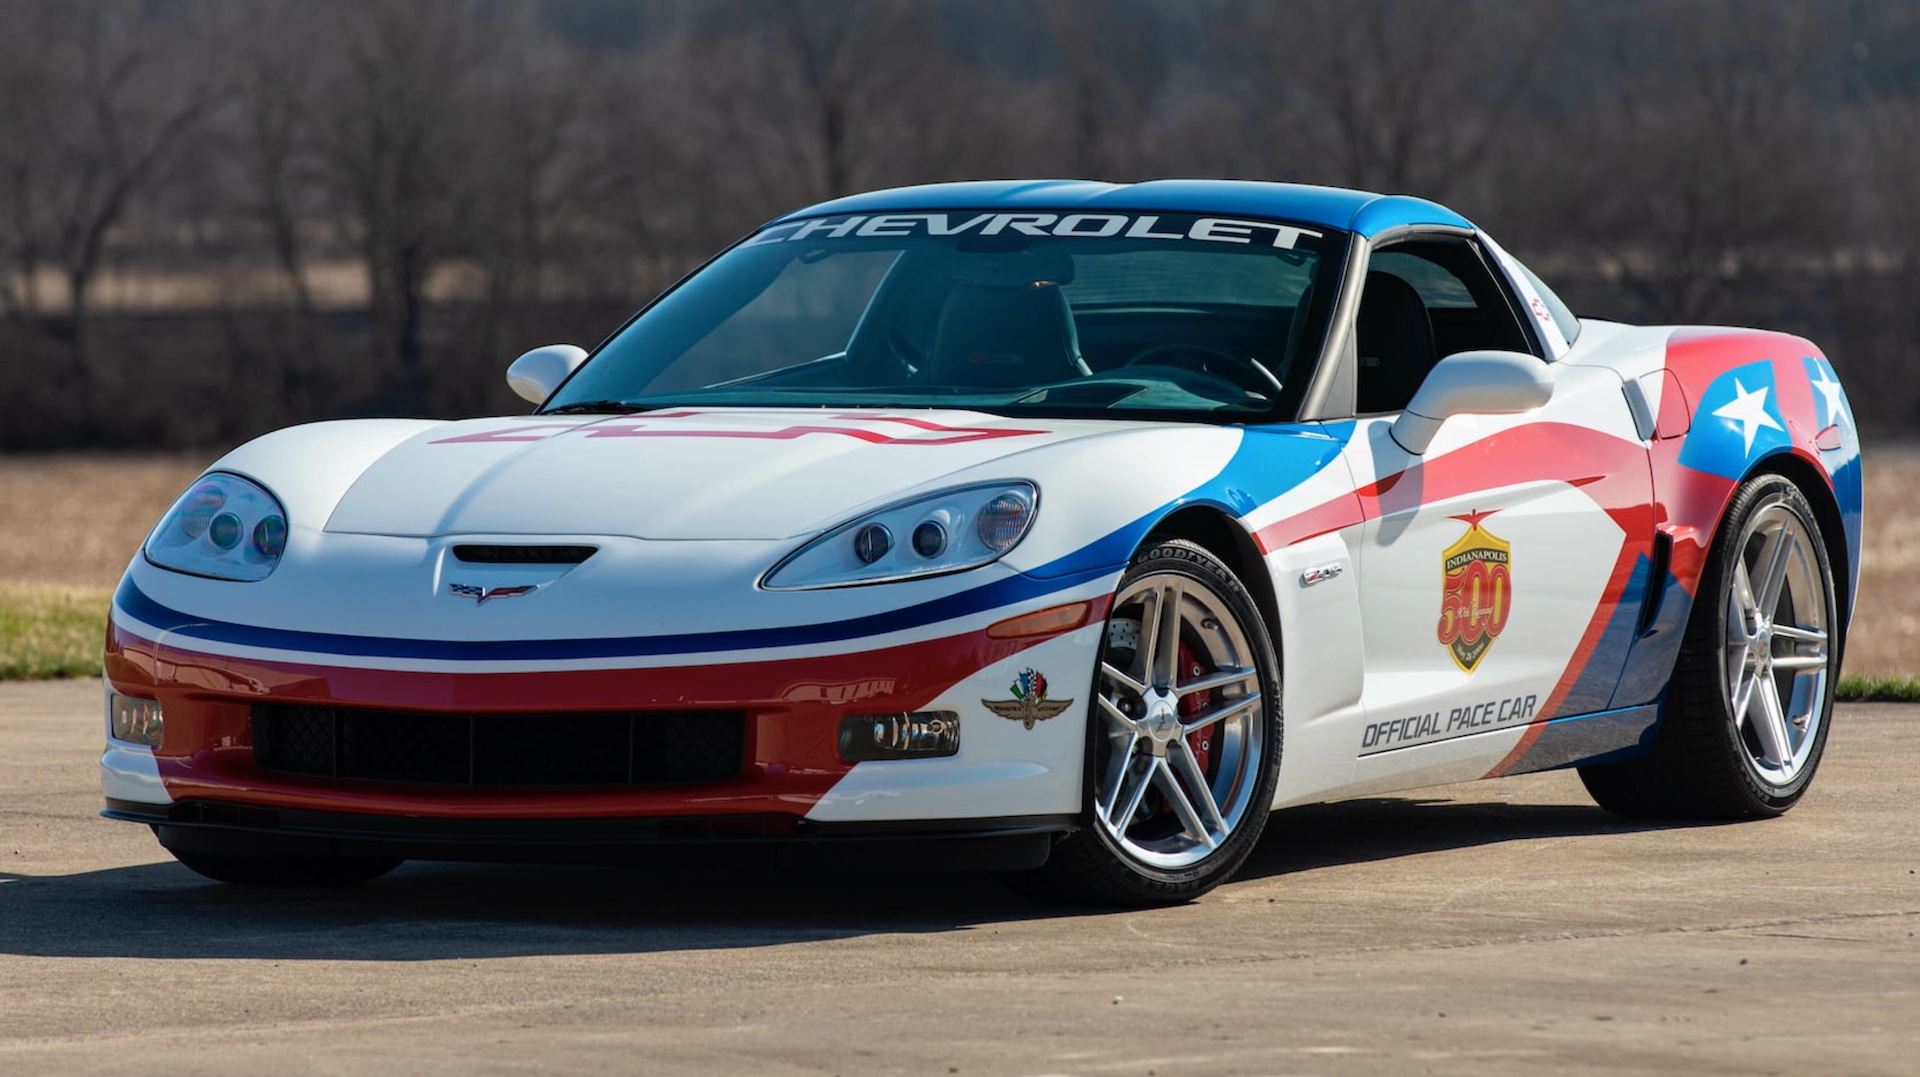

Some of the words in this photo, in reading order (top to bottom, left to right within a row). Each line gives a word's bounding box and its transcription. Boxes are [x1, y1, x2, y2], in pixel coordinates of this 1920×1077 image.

[740, 213, 1323, 250] CHEVROLET
[1446, 550, 1508, 570] INDIANAPOLIS
[1437, 558, 1512, 645] 500
[1362, 712, 1441, 748] OFFICIAL
[1446, 702, 1496, 732] PACE
[1497, 694, 1537, 722] CAR
